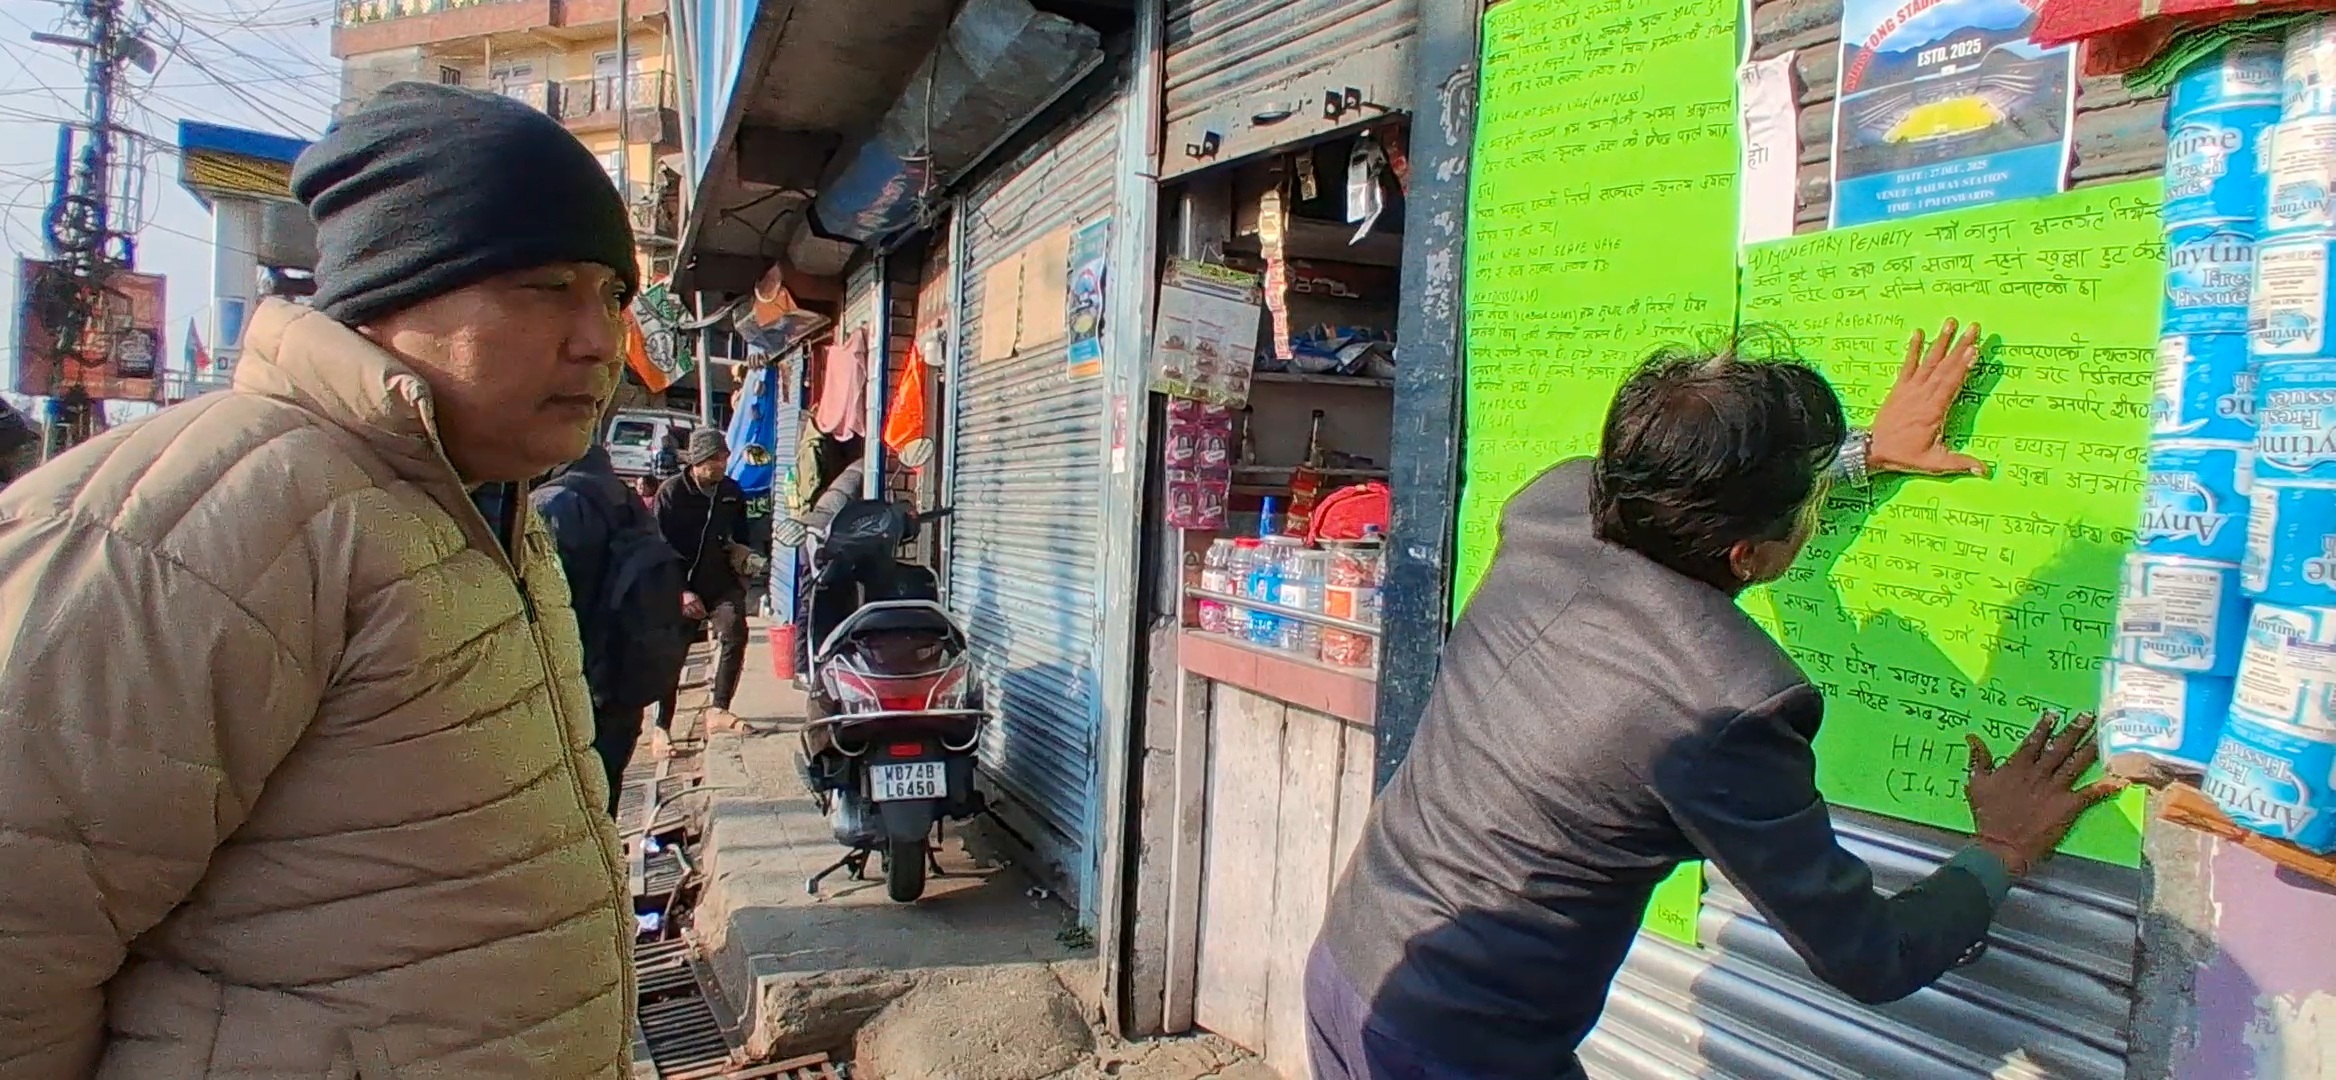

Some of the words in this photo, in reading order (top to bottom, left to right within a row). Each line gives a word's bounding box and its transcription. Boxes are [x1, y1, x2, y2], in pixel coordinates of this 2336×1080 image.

[1917, 47, 1949, 67] ESTD.
[1950, 39, 1982, 60] 2025
[1876, 186, 1907, 200] VENUE
[1915, 178, 1961, 195] RAILWAY
[1962, 171, 2009, 186] STATION
[1897, 172, 1923, 184] DATE
[1887, 202, 1909, 213] TIME
[1767, 235, 1843, 266] MONETARY
[1849, 229, 1914, 253] PENALTY
[2203, 267, 2252, 288] Fres
[886, 781, 935, 798] L6450
